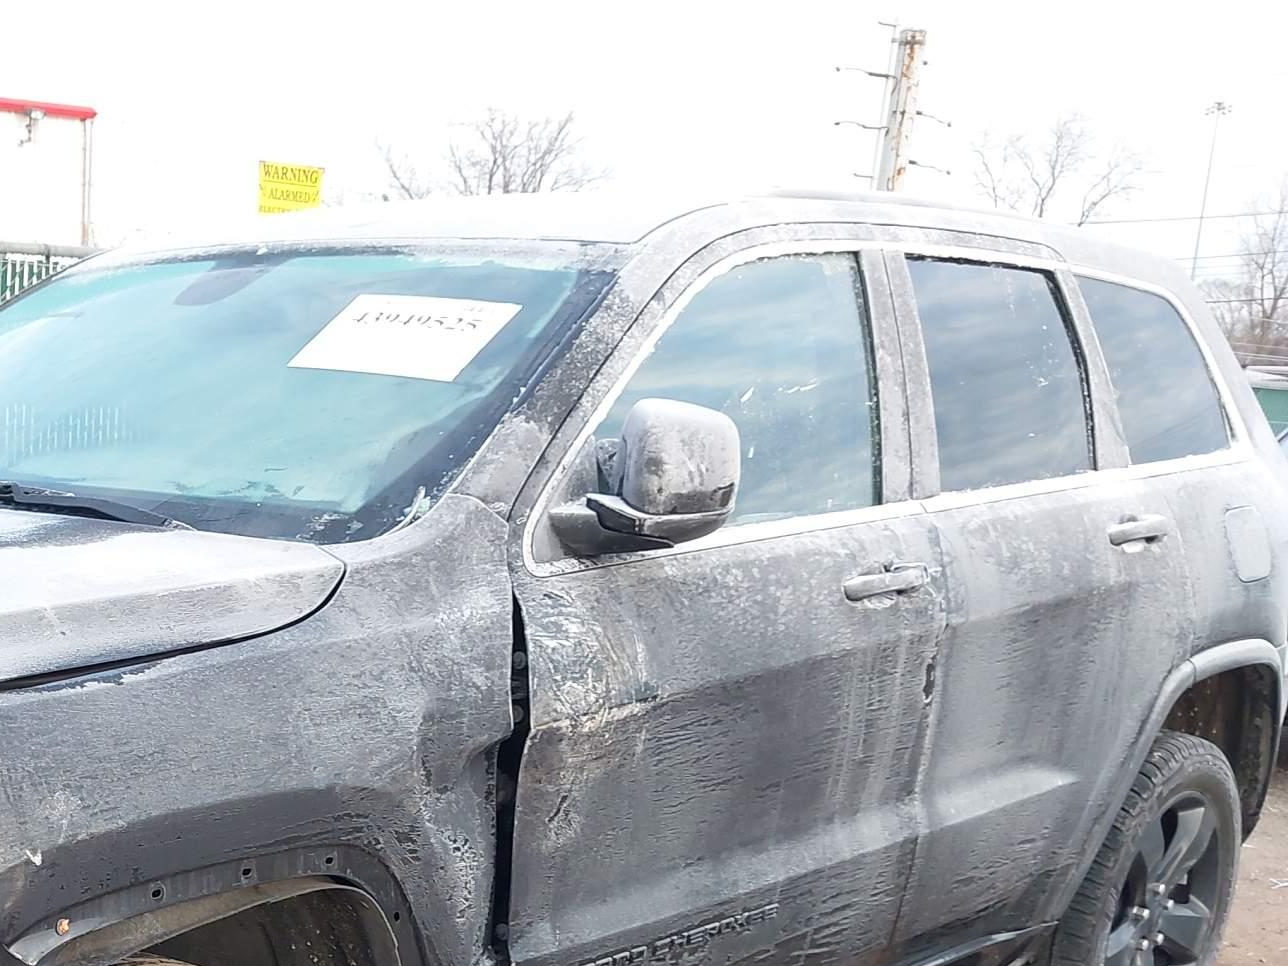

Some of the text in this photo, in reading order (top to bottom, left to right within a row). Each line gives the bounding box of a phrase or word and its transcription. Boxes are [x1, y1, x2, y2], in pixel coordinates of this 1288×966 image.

[260, 164, 319, 184] WARNING
[269, 188, 311, 203] ALARMED
[652, 903, 780, 957] CHEROKEE
